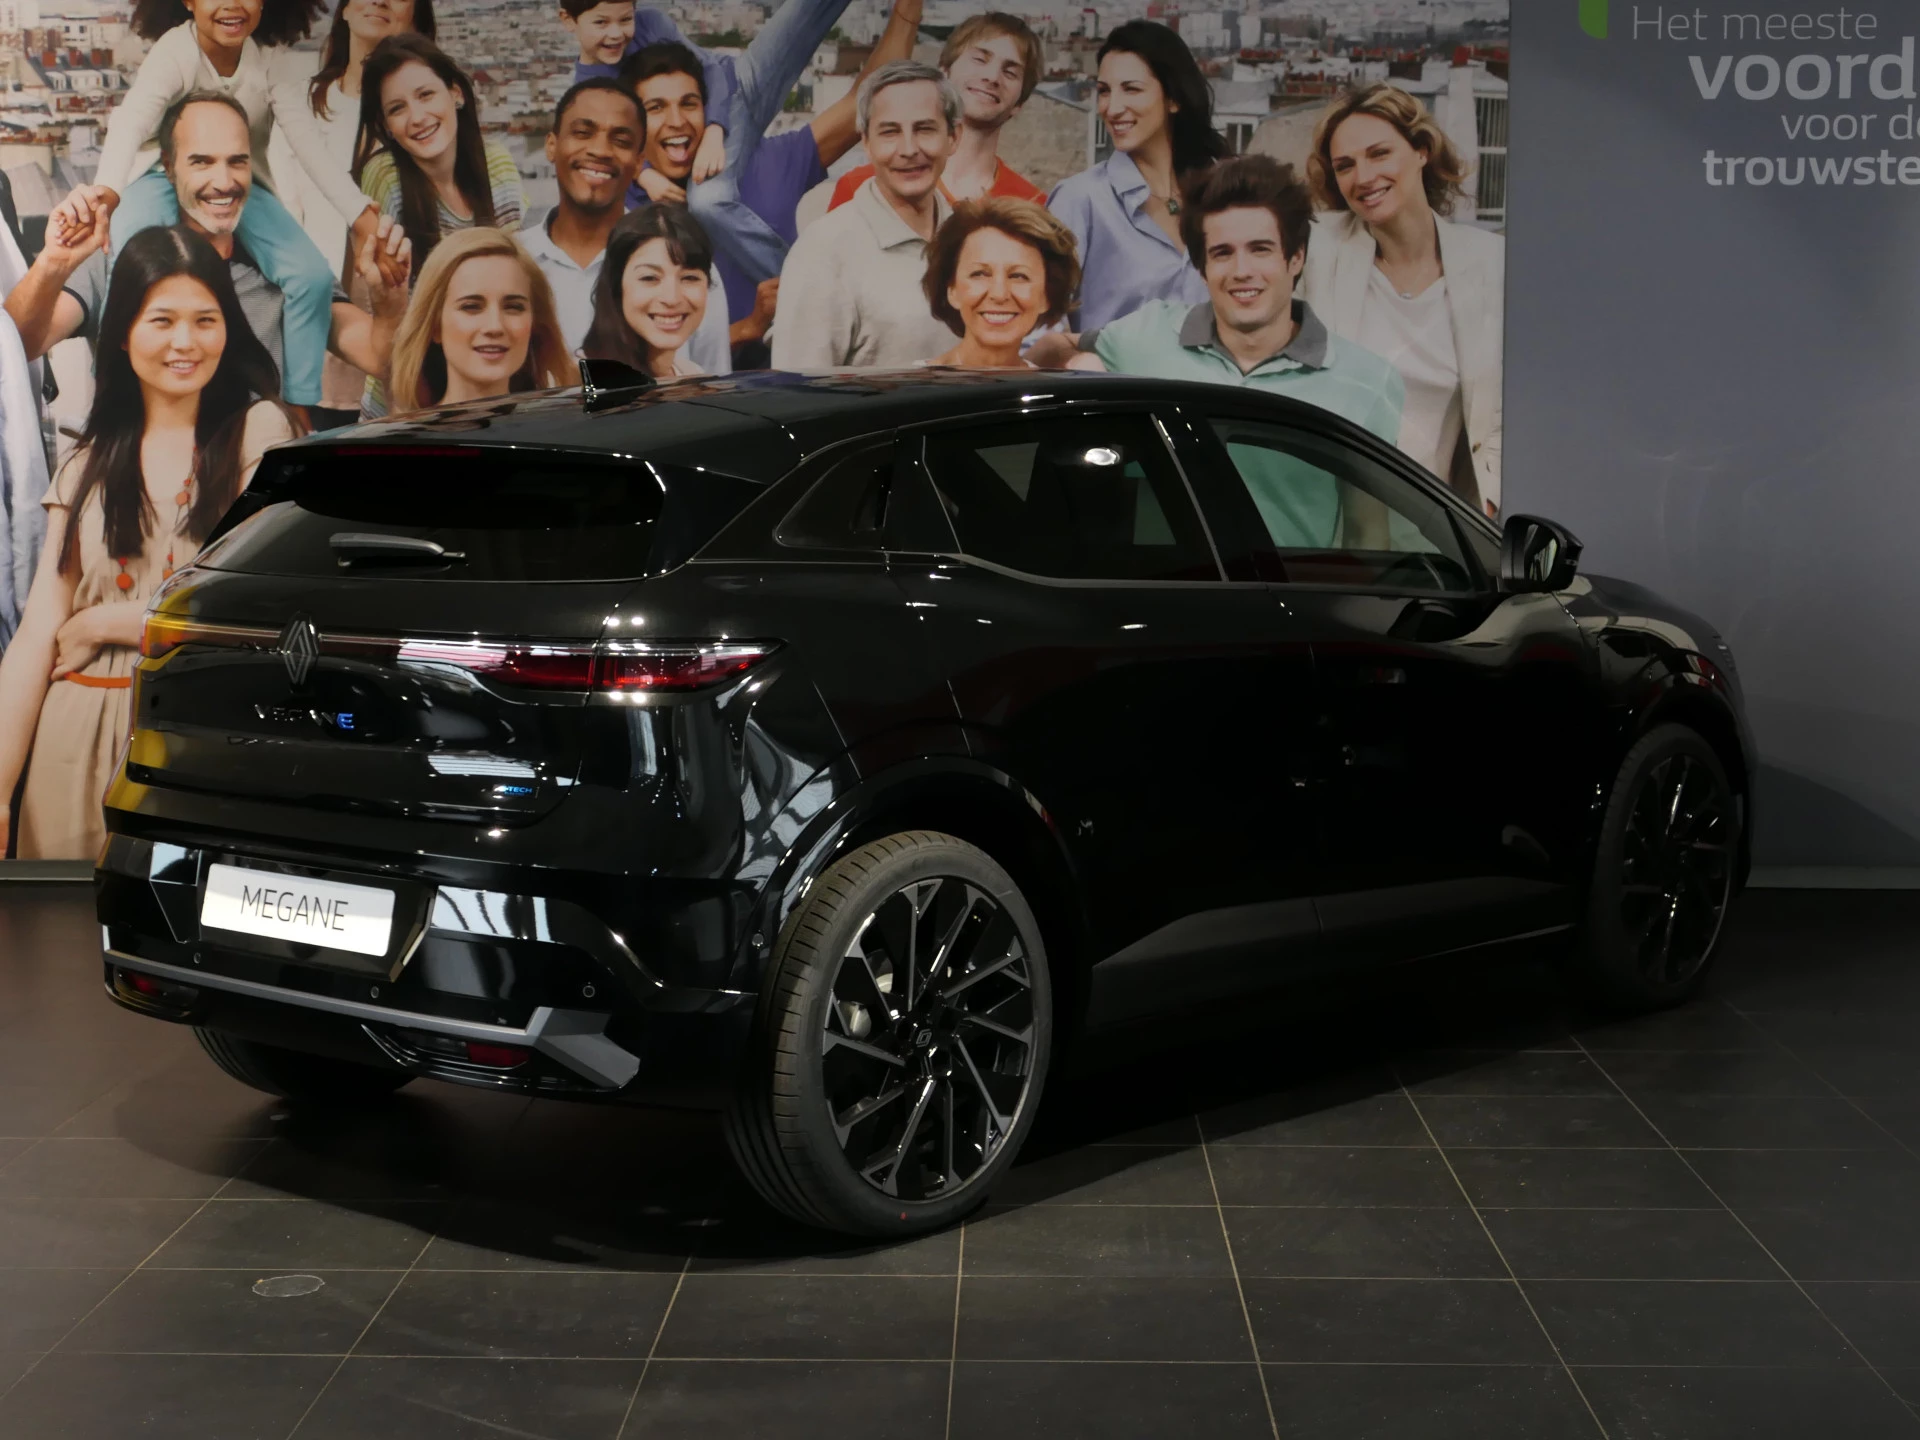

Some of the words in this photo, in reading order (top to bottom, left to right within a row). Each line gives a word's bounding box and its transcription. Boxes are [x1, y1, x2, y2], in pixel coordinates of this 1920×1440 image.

[1633, 6, 1707, 40] Het
[1723, 7, 1878, 40] meeste
[1688, 36, 1917, 100] voord
[1781, 113, 1877, 140] voor
[1888, 104, 1920, 140] d
[1702, 149, 1920, 186] trouwste
[241, 885, 349, 931] MEGANE
